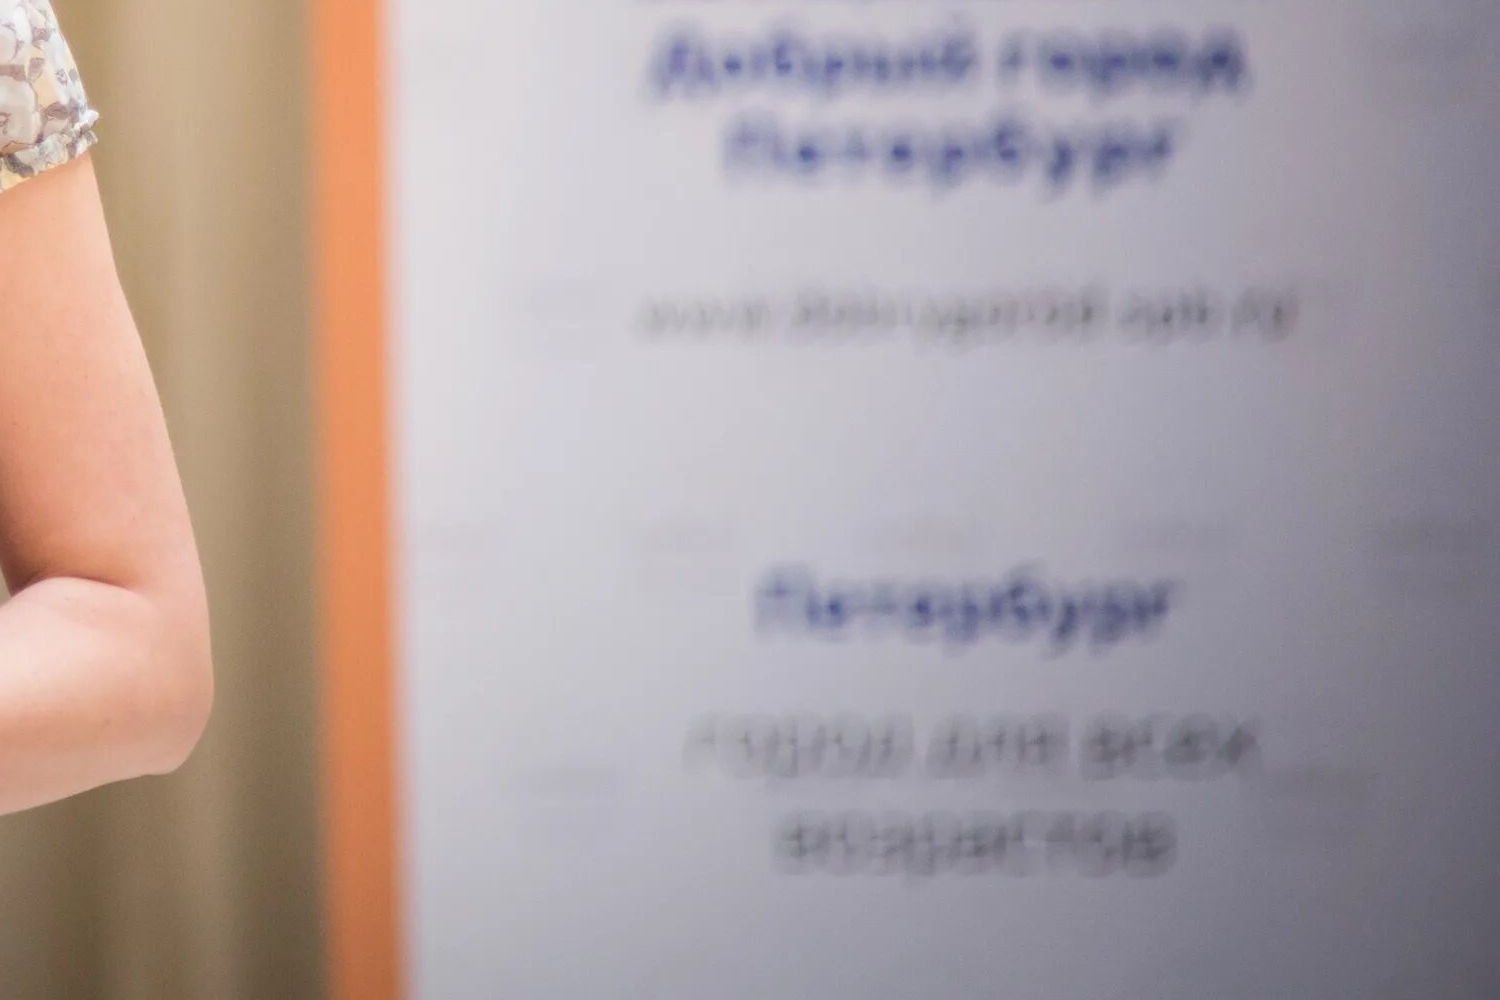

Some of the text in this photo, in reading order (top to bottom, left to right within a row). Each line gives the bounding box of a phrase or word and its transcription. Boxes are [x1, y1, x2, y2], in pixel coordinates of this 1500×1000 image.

[643, 18, 1253, 104] Добрый город
[720, 112, 1184, 196] Петербург
[753, 564, 1182, 658] Петербург
[686, 712, 1262, 784] город для всех
[774, 812, 1180, 882] возрастов
